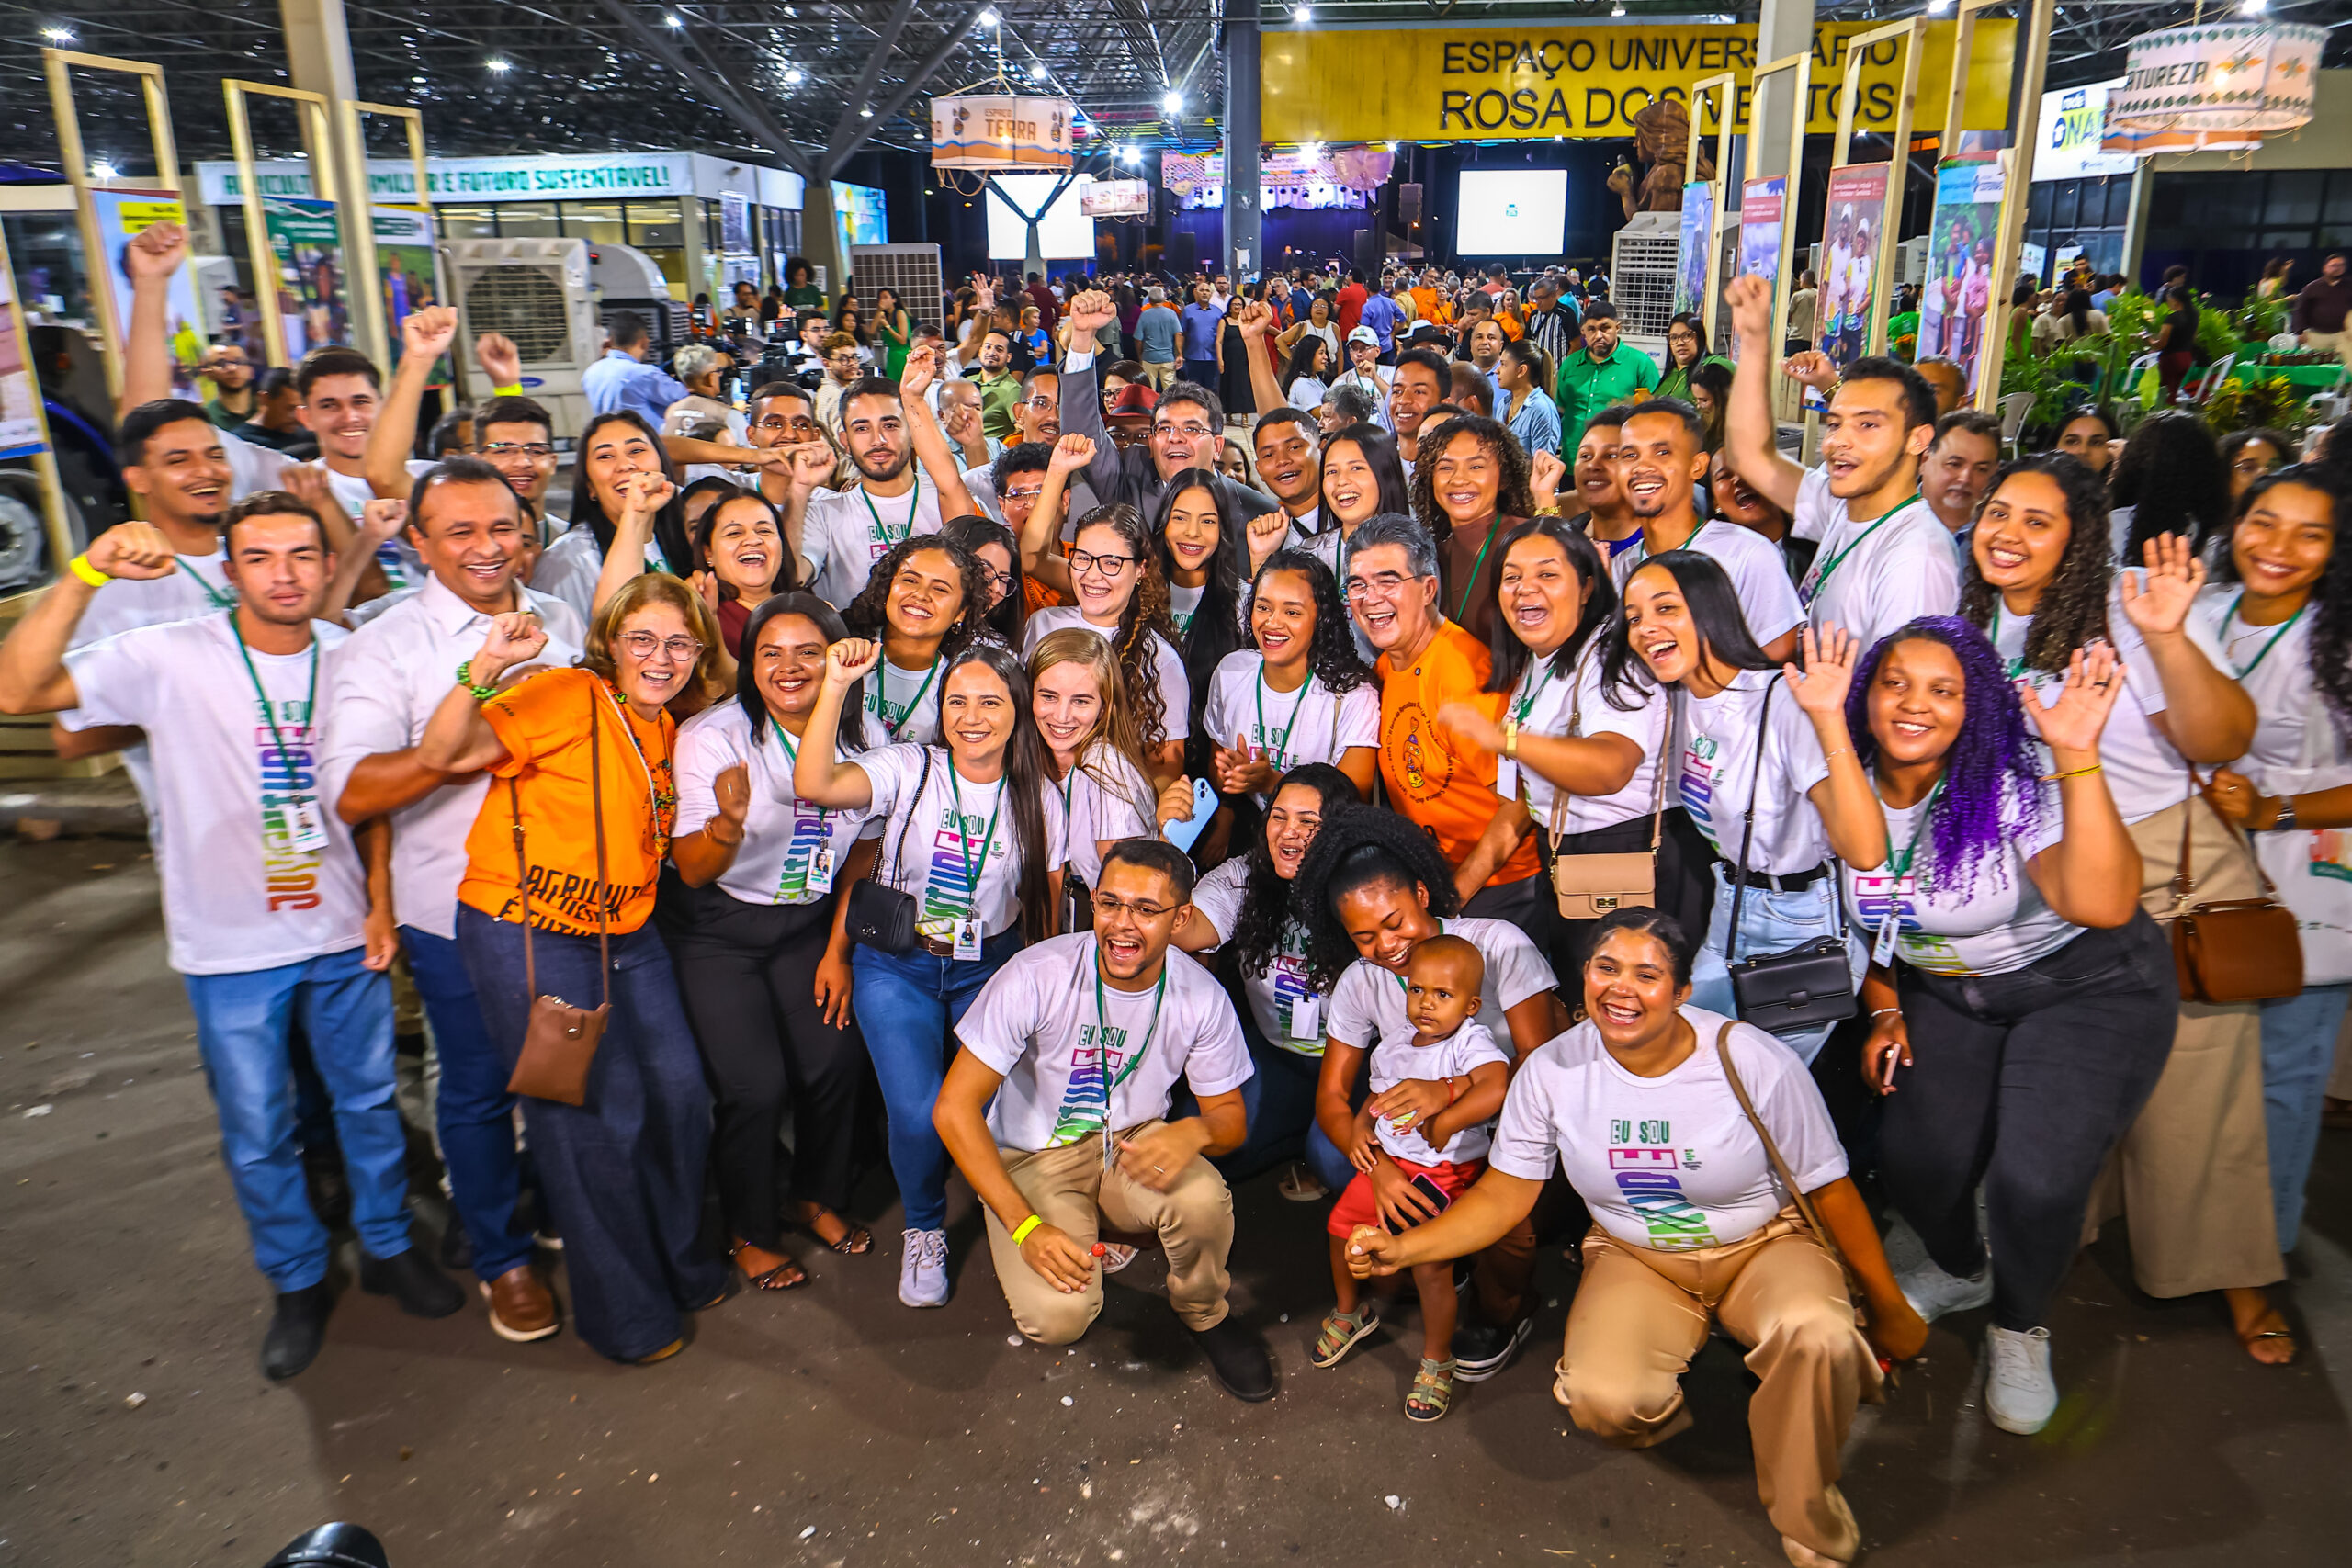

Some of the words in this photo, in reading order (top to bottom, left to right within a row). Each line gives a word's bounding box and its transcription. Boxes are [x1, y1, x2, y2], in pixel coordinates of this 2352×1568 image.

[1442, 39, 1596, 79] ESPAÇO
[2124, 61, 2210, 91] ATUREZA
[1439, 88, 1573, 130] ROSA
[1702, 83, 1894, 124] VETOS
[985, 118, 1037, 141] TERRA
[458, 171, 529, 191] FUTURO
[867, 526, 883, 542] EU
[941, 808, 957, 829] EU
[963, 814, 986, 836] SOU
[1078, 1024, 1096, 1046] EU
[1100, 1026, 1128, 1048] SOU
[1611, 1119, 1631, 1144] EU
[1639, 1120, 1670, 1145] SOU
